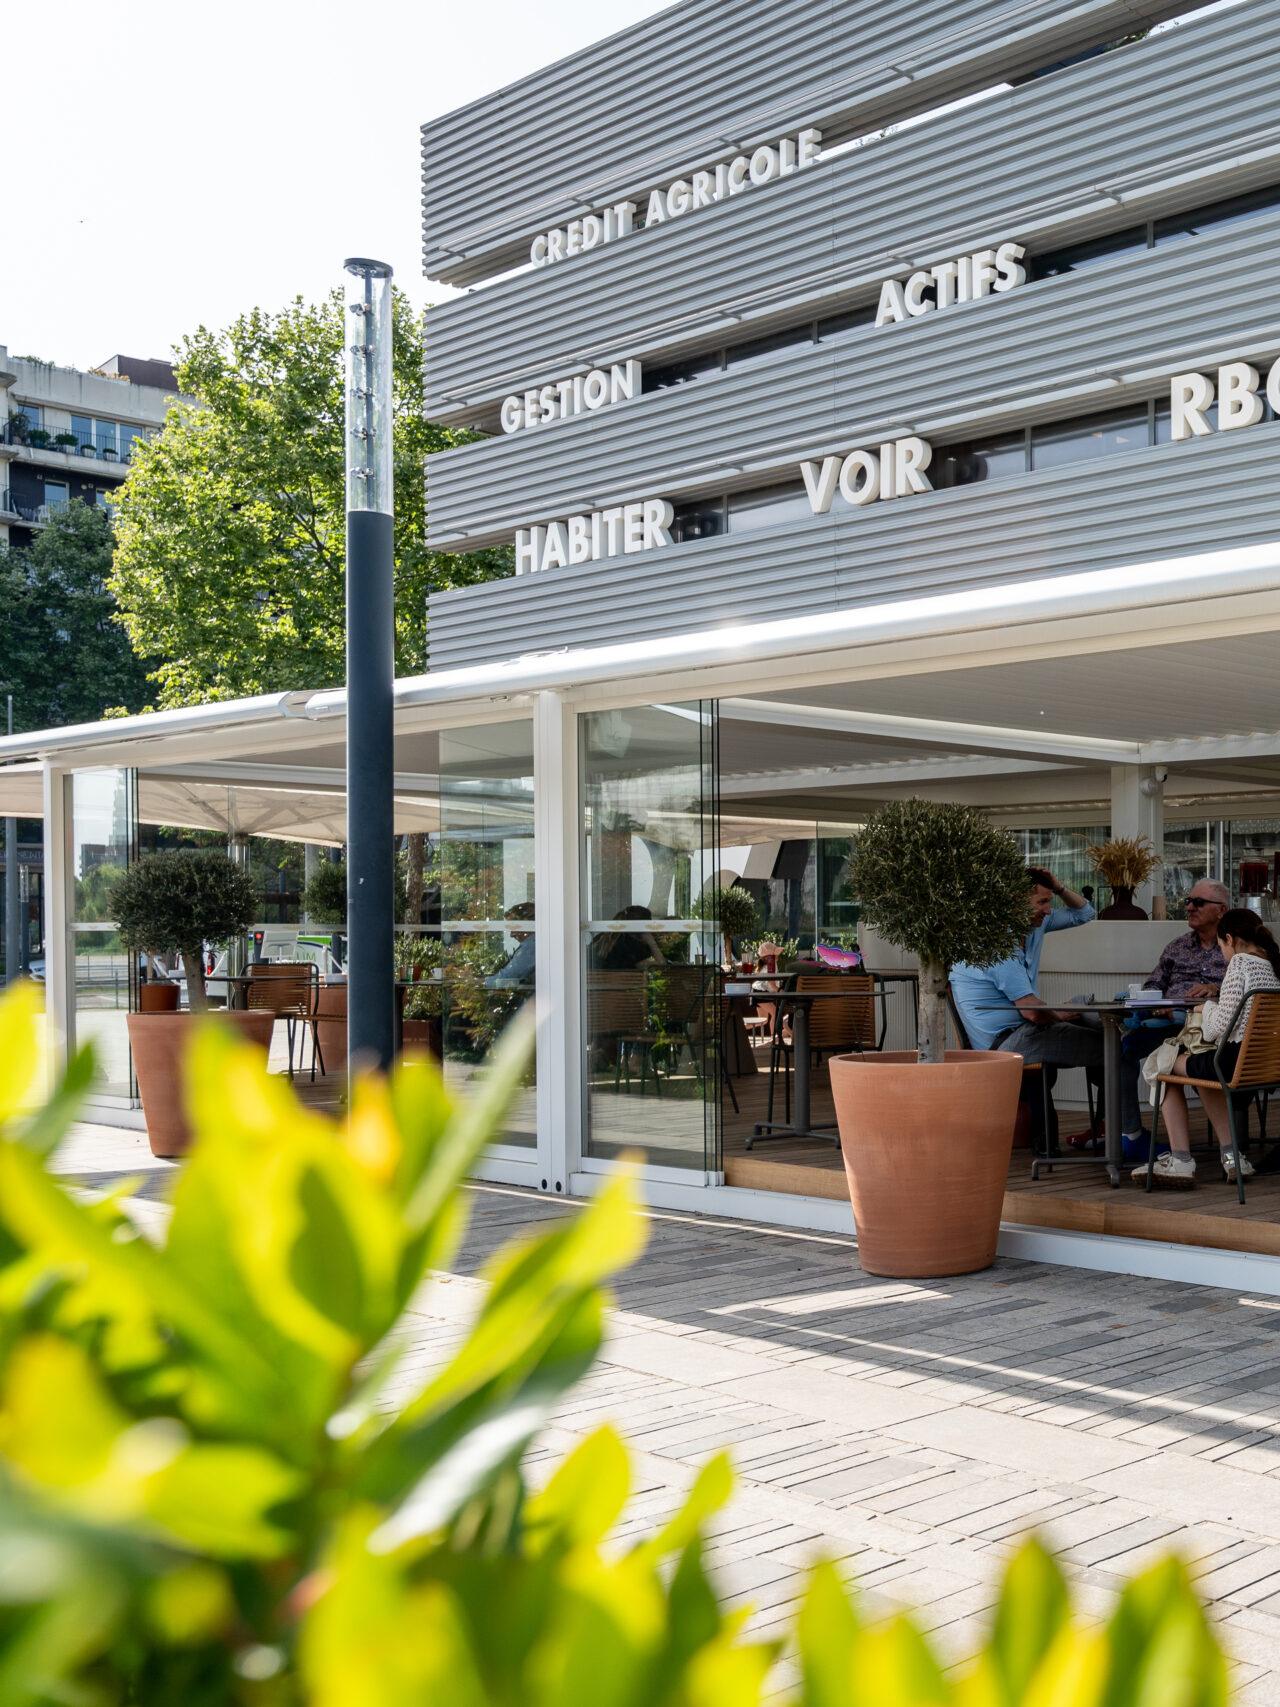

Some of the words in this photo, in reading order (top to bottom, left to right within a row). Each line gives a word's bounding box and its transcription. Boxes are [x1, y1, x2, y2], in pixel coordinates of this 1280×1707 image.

[530, 200, 638, 269] CREDIT
[644, 128, 823, 227] AGRICOLE
[874, 243, 1027, 327] ACTIFS
[500, 360, 642, 434] GESTION
[800, 437, 933, 514] VOIR
[515, 498, 675, 575] HABITER
